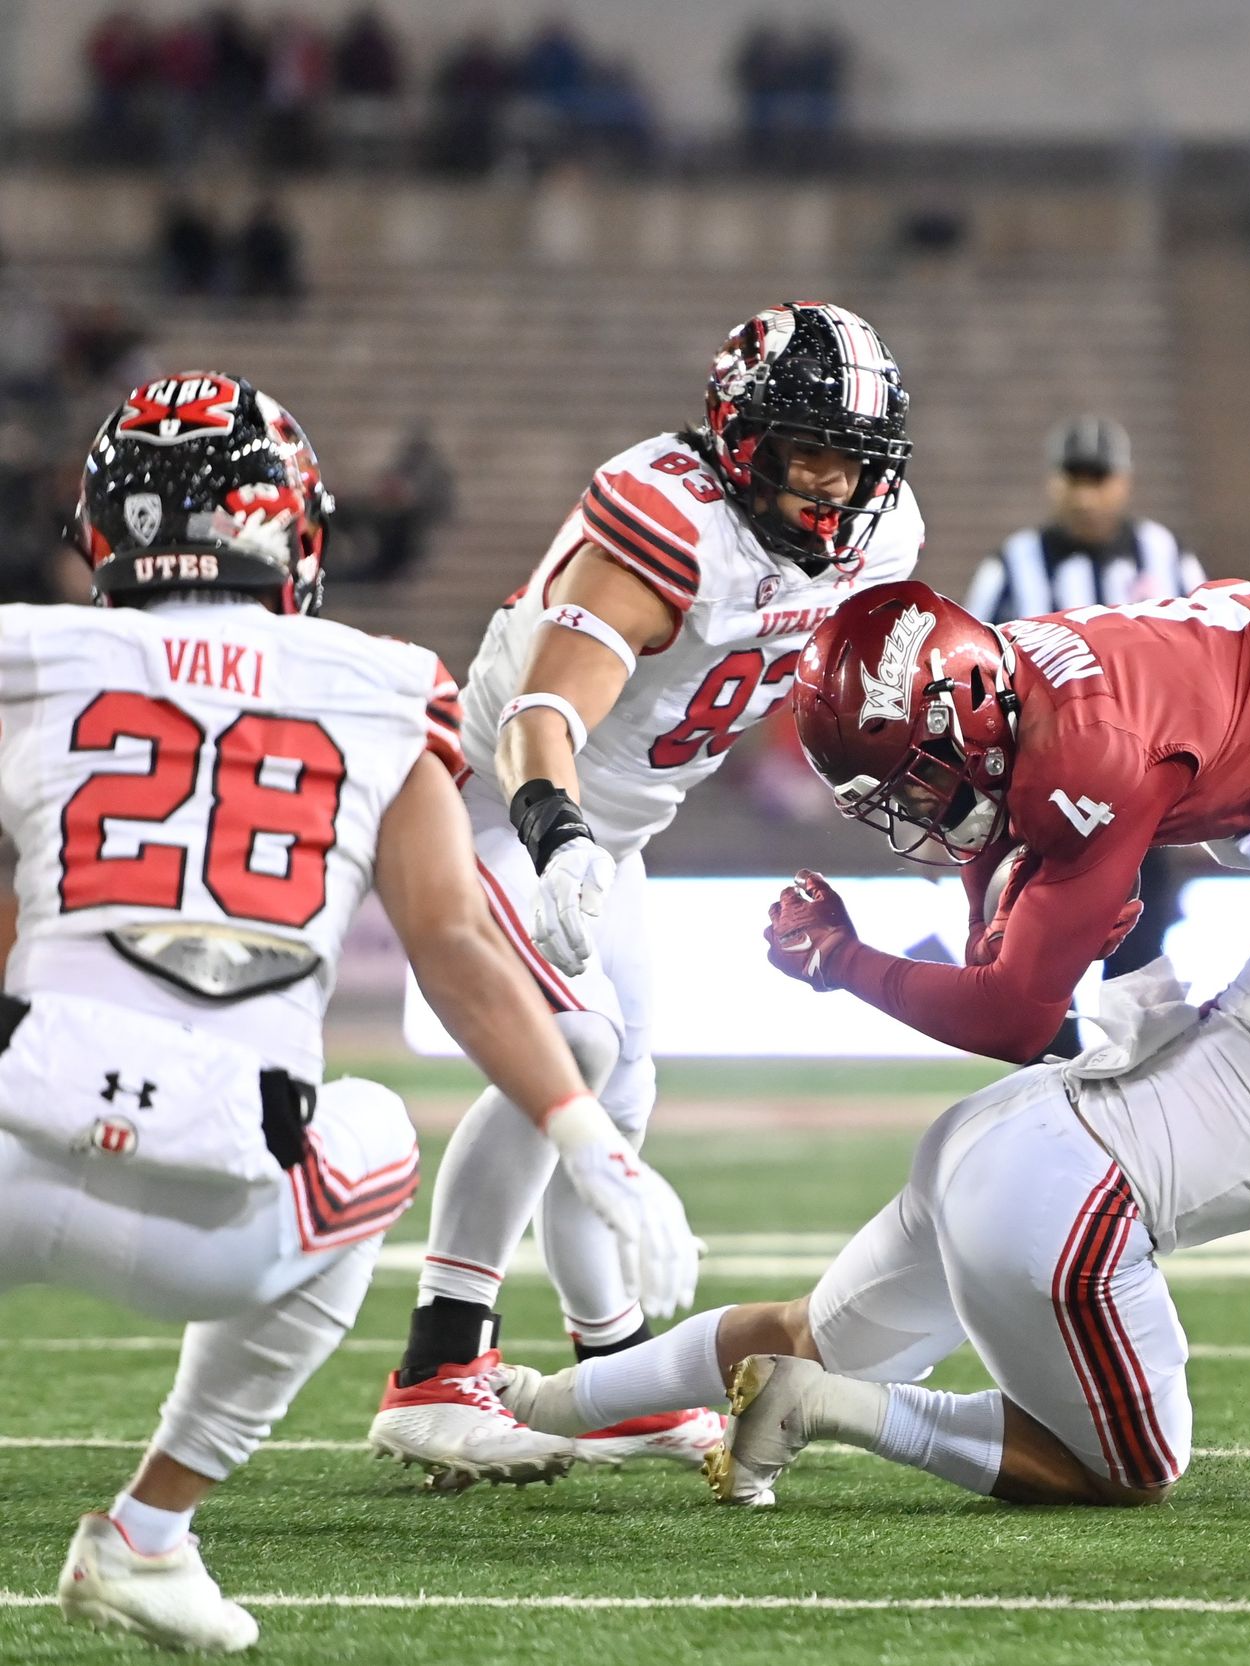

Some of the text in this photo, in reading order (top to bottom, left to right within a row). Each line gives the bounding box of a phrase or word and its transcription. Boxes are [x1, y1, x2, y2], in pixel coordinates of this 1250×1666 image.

[650, 450, 723, 504] 83
[134, 553, 219, 583] UTES
[756, 606, 833, 638] UTAH
[163, 637, 264, 699] VAKI
[858, 603, 937, 730] Wazzu
[59, 689, 348, 930] 28
[1048, 788, 1116, 839] 4
[101, 1124, 130, 1153] U
